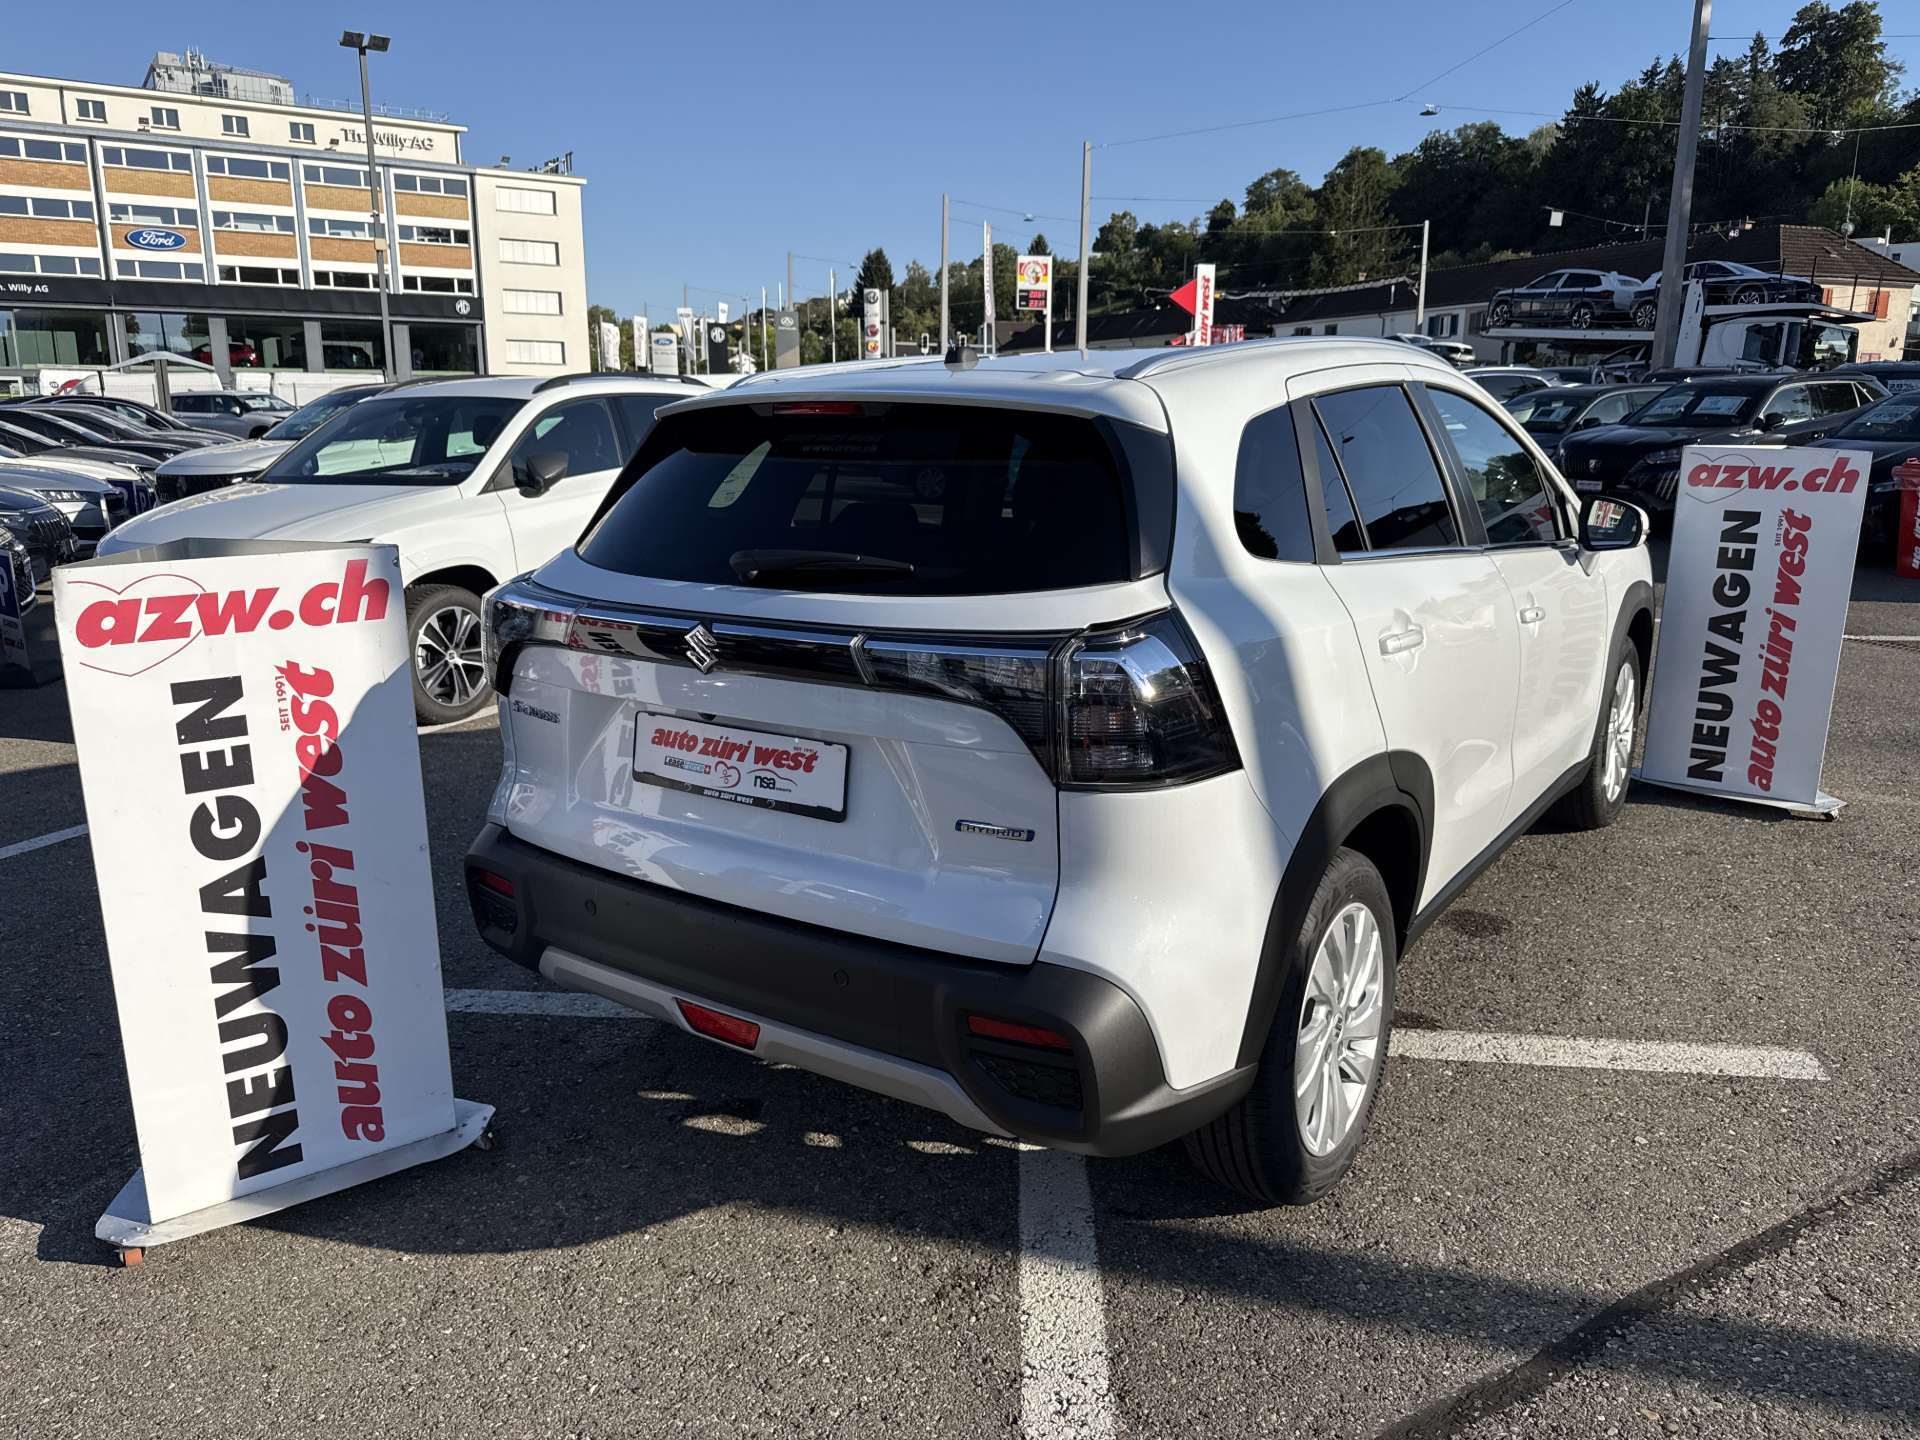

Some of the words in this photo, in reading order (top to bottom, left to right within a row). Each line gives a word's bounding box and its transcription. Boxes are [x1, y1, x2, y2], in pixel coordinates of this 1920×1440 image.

[371, 132, 407, 151] Willy
[409, 136, 434, 151] AG
[139, 231, 175, 247] Ford
[8, 283, 32, 294] Willy
[35, 284, 49, 293] AG
[1687, 457, 1860, 494] azw.ch
[1774, 507, 1812, 605] west
[76, 559, 390, 648] azw.ch
[1687, 510, 1761, 782] NEUWAGEN
[1758, 607, 1797, 701] züri
[275, 675, 288, 704] 1991
[279, 707, 291, 732] SEIT
[274, 660, 349, 831] west
[651, 728, 698, 752] auto
[703, 736, 752, 763] züri
[754, 746, 819, 773] west
[1748, 699, 1783, 793] auto
[704, 789, 719, 797] auto
[721, 791, 735, 800] züri
[737, 795, 754, 804] west
[754, 775, 775, 790] nsa
[966, 824, 1025, 838] HYBRID
[170, 676, 303, 1180] NEUWAGEN
[295, 840, 369, 987] züri
[320, 994, 385, 1142] auto
